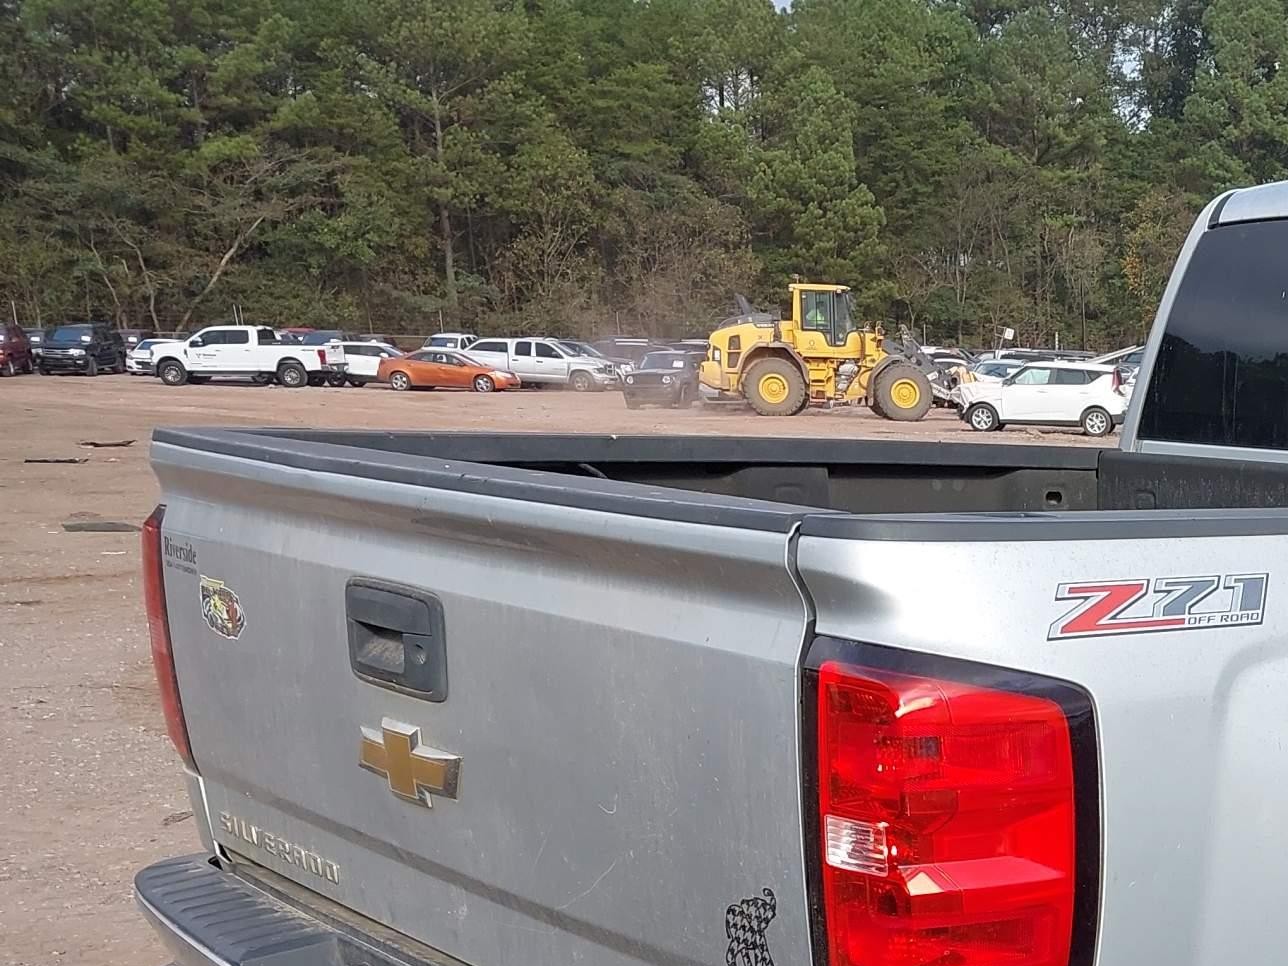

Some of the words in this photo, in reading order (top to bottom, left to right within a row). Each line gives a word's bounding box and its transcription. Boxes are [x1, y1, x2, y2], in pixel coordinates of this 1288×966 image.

[163, 535, 198, 565] Riverside
[1047, 573, 1268, 640] Z71
[1188, 615, 1216, 625] OFF
[1220, 612, 1260, 623] ROAD
[220, 811, 340, 885] SILVERADO
